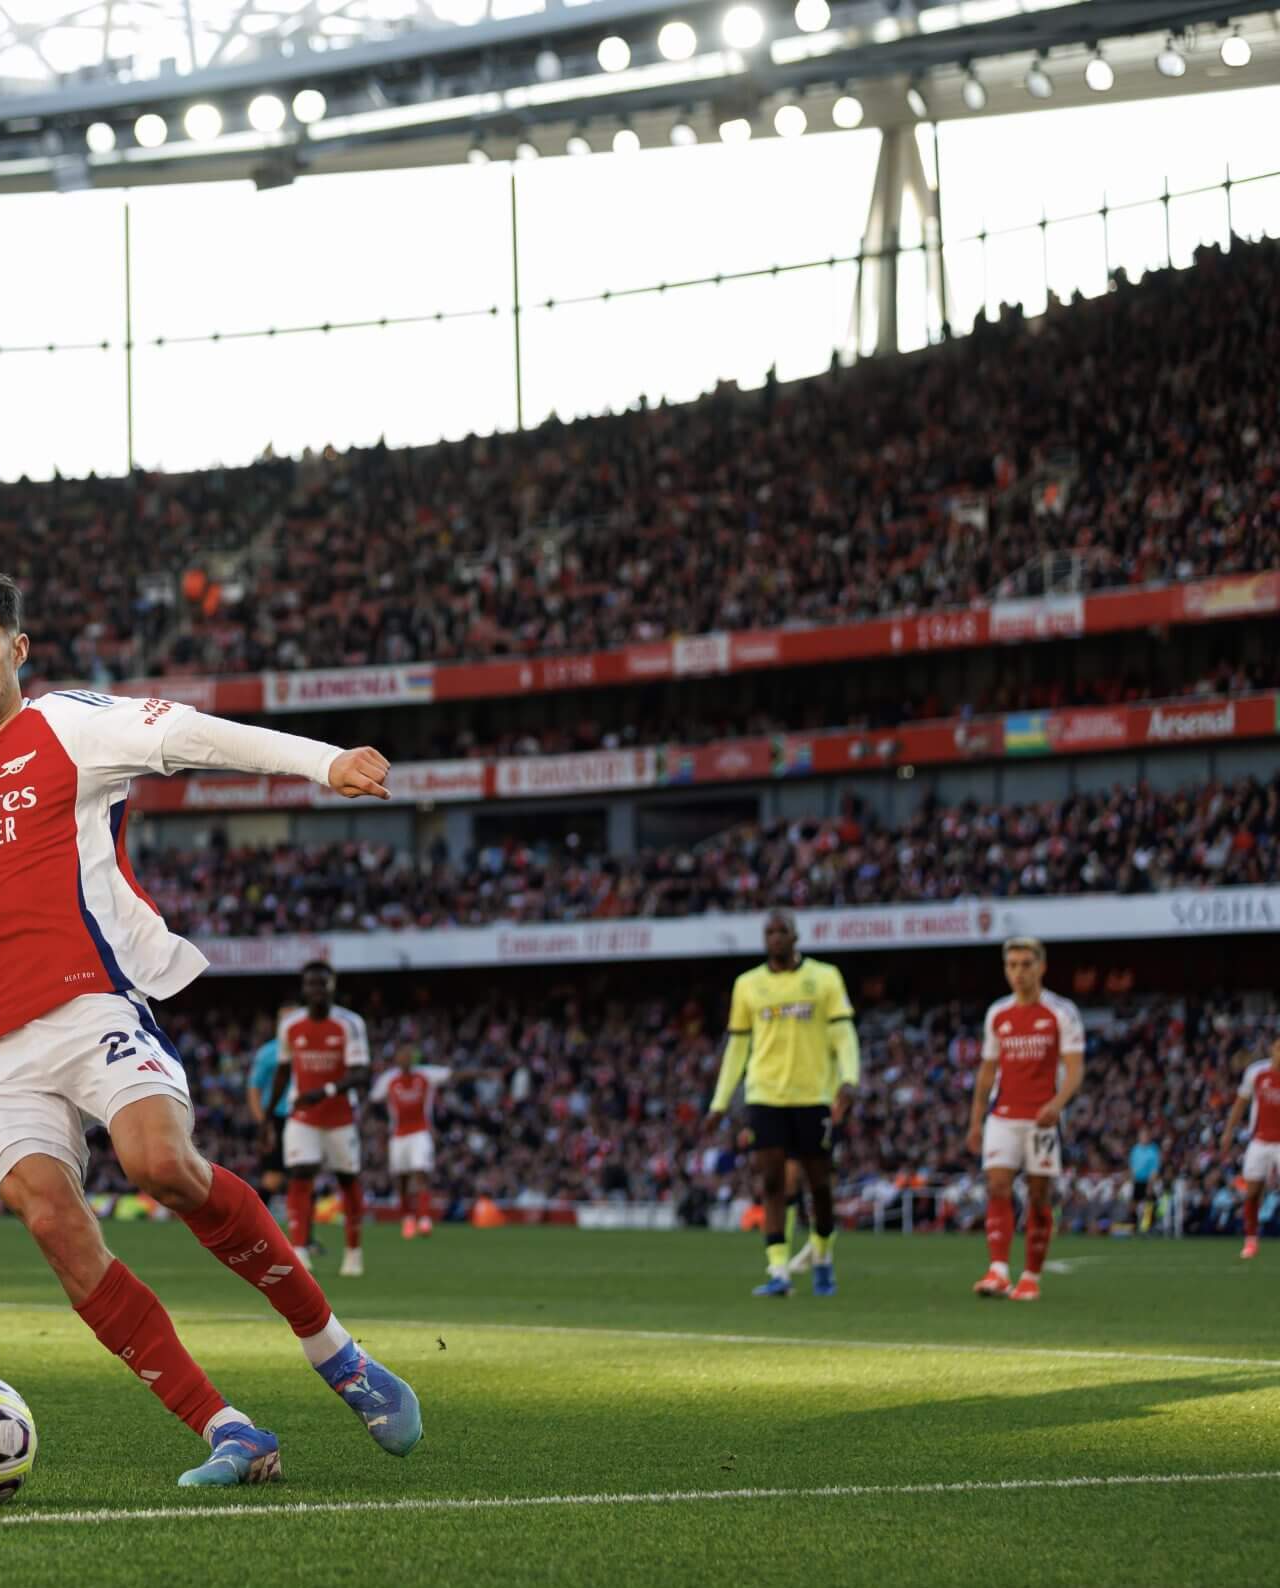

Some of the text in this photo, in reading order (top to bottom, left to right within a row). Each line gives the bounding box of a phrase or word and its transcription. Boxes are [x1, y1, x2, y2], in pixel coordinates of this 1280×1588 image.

[299, 671, 401, 699] ARMENIA
[139, 698, 161, 713] VIS
[228, 1239, 269, 1265] AFC
